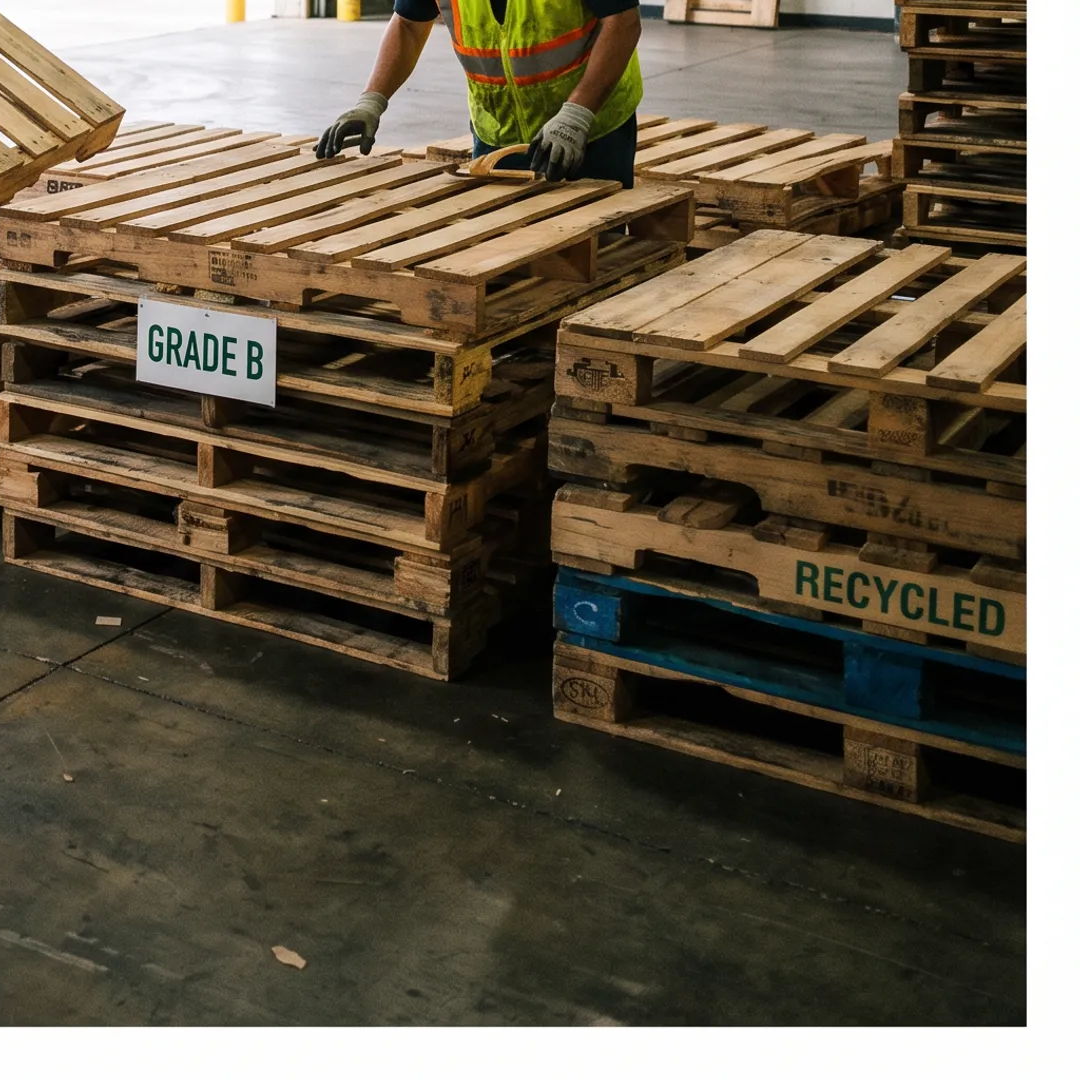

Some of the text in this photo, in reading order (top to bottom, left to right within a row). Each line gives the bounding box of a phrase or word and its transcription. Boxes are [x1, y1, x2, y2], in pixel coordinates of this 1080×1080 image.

[148, 324, 264, 380] GRADE B
[795, 560, 1006, 637] RECYCLED
